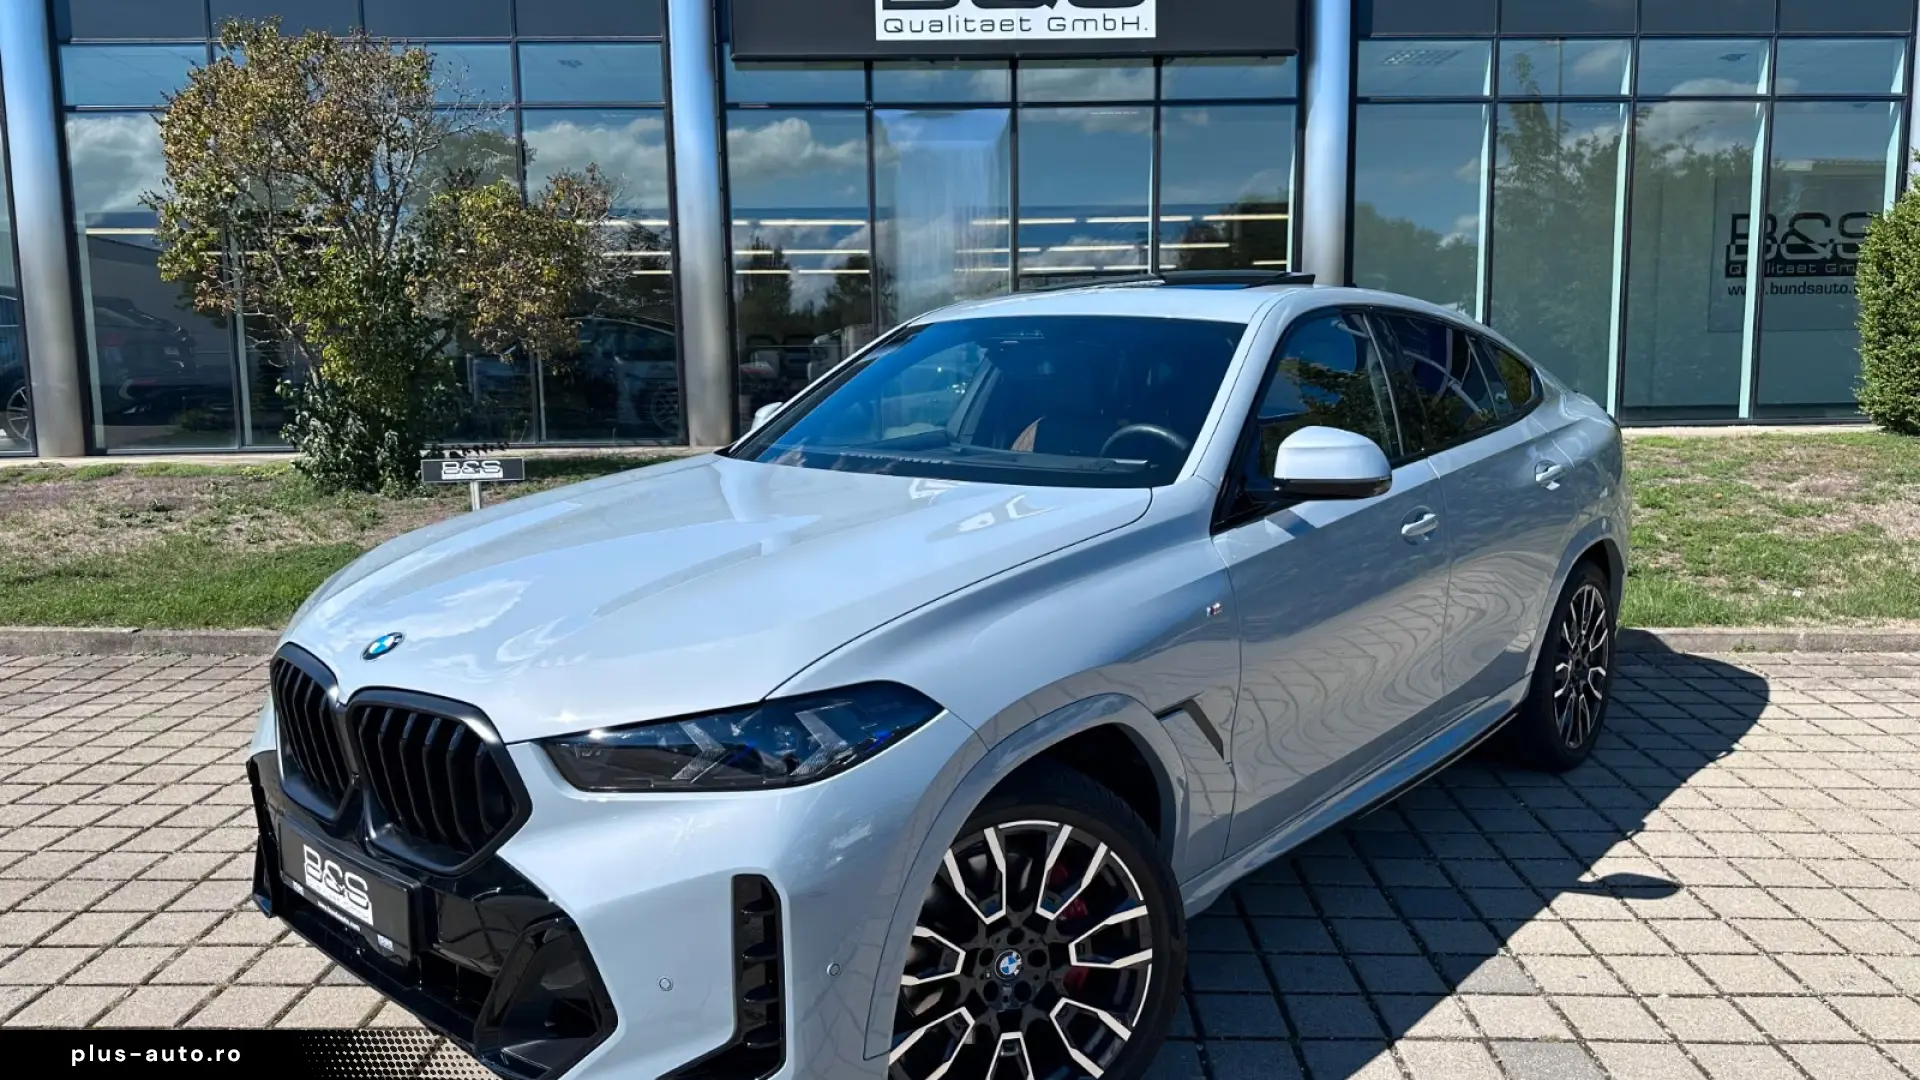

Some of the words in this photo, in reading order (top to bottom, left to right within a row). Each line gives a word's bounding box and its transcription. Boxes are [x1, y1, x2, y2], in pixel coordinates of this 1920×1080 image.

[883, 14, 1032, 33] Qualitaet
[1047, 13, 1148, 32] GmbH.
[442, 461, 501, 474] B&S
[303, 844, 370, 910] B&S
